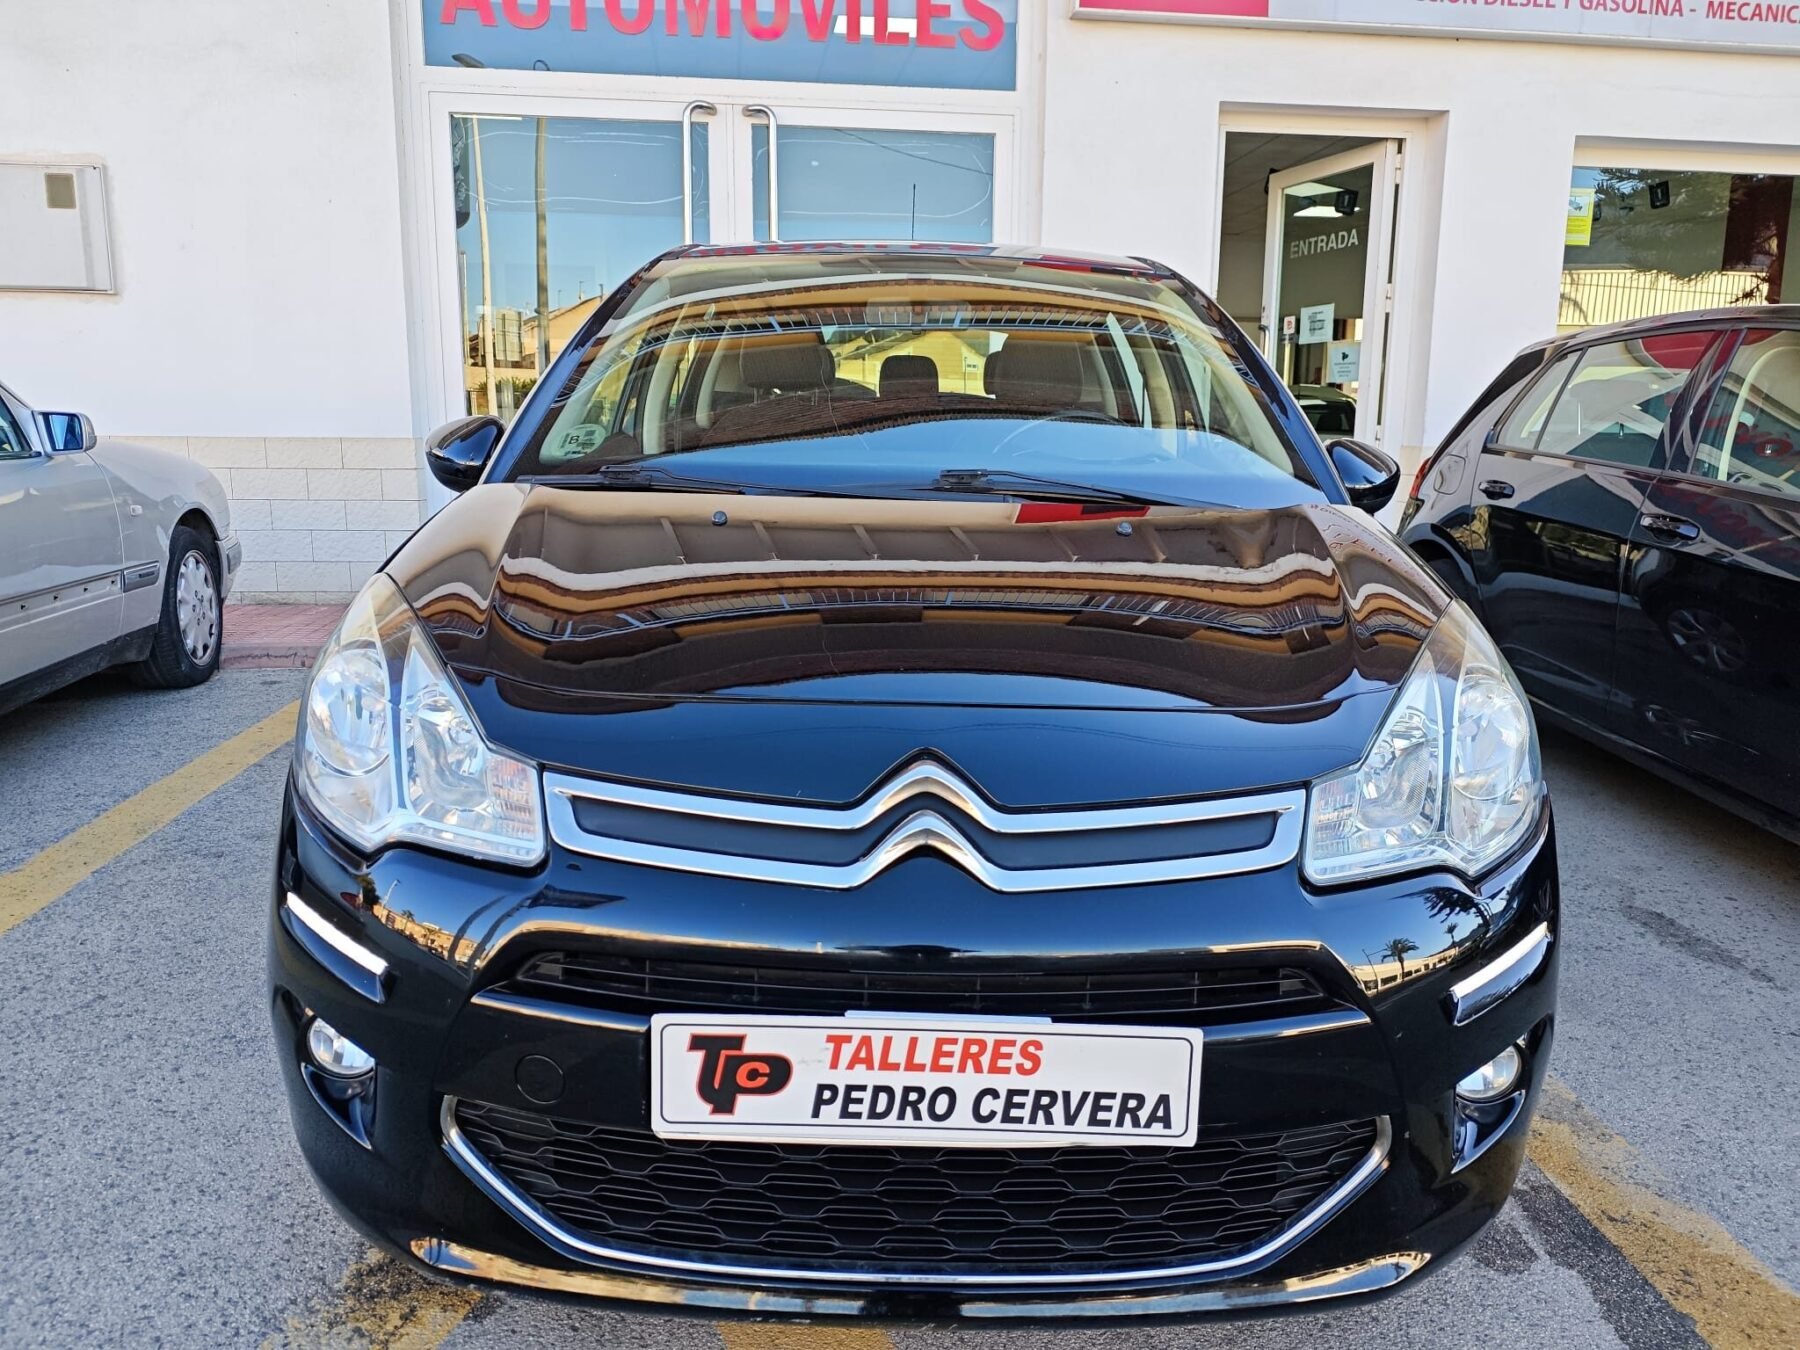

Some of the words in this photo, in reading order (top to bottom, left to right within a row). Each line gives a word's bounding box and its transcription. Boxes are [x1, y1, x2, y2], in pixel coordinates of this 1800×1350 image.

[1579, 0, 1684, 17] GASOLINA
[1705, 1, 1800, 24] MECANIC
[1290, 228, 1359, 259] ENTRADA
[825, 1034, 1044, 1076] TALLERES
[811, 1083, 958, 1122] PEDRO
[971, 1087, 1173, 1130] CERVERA
